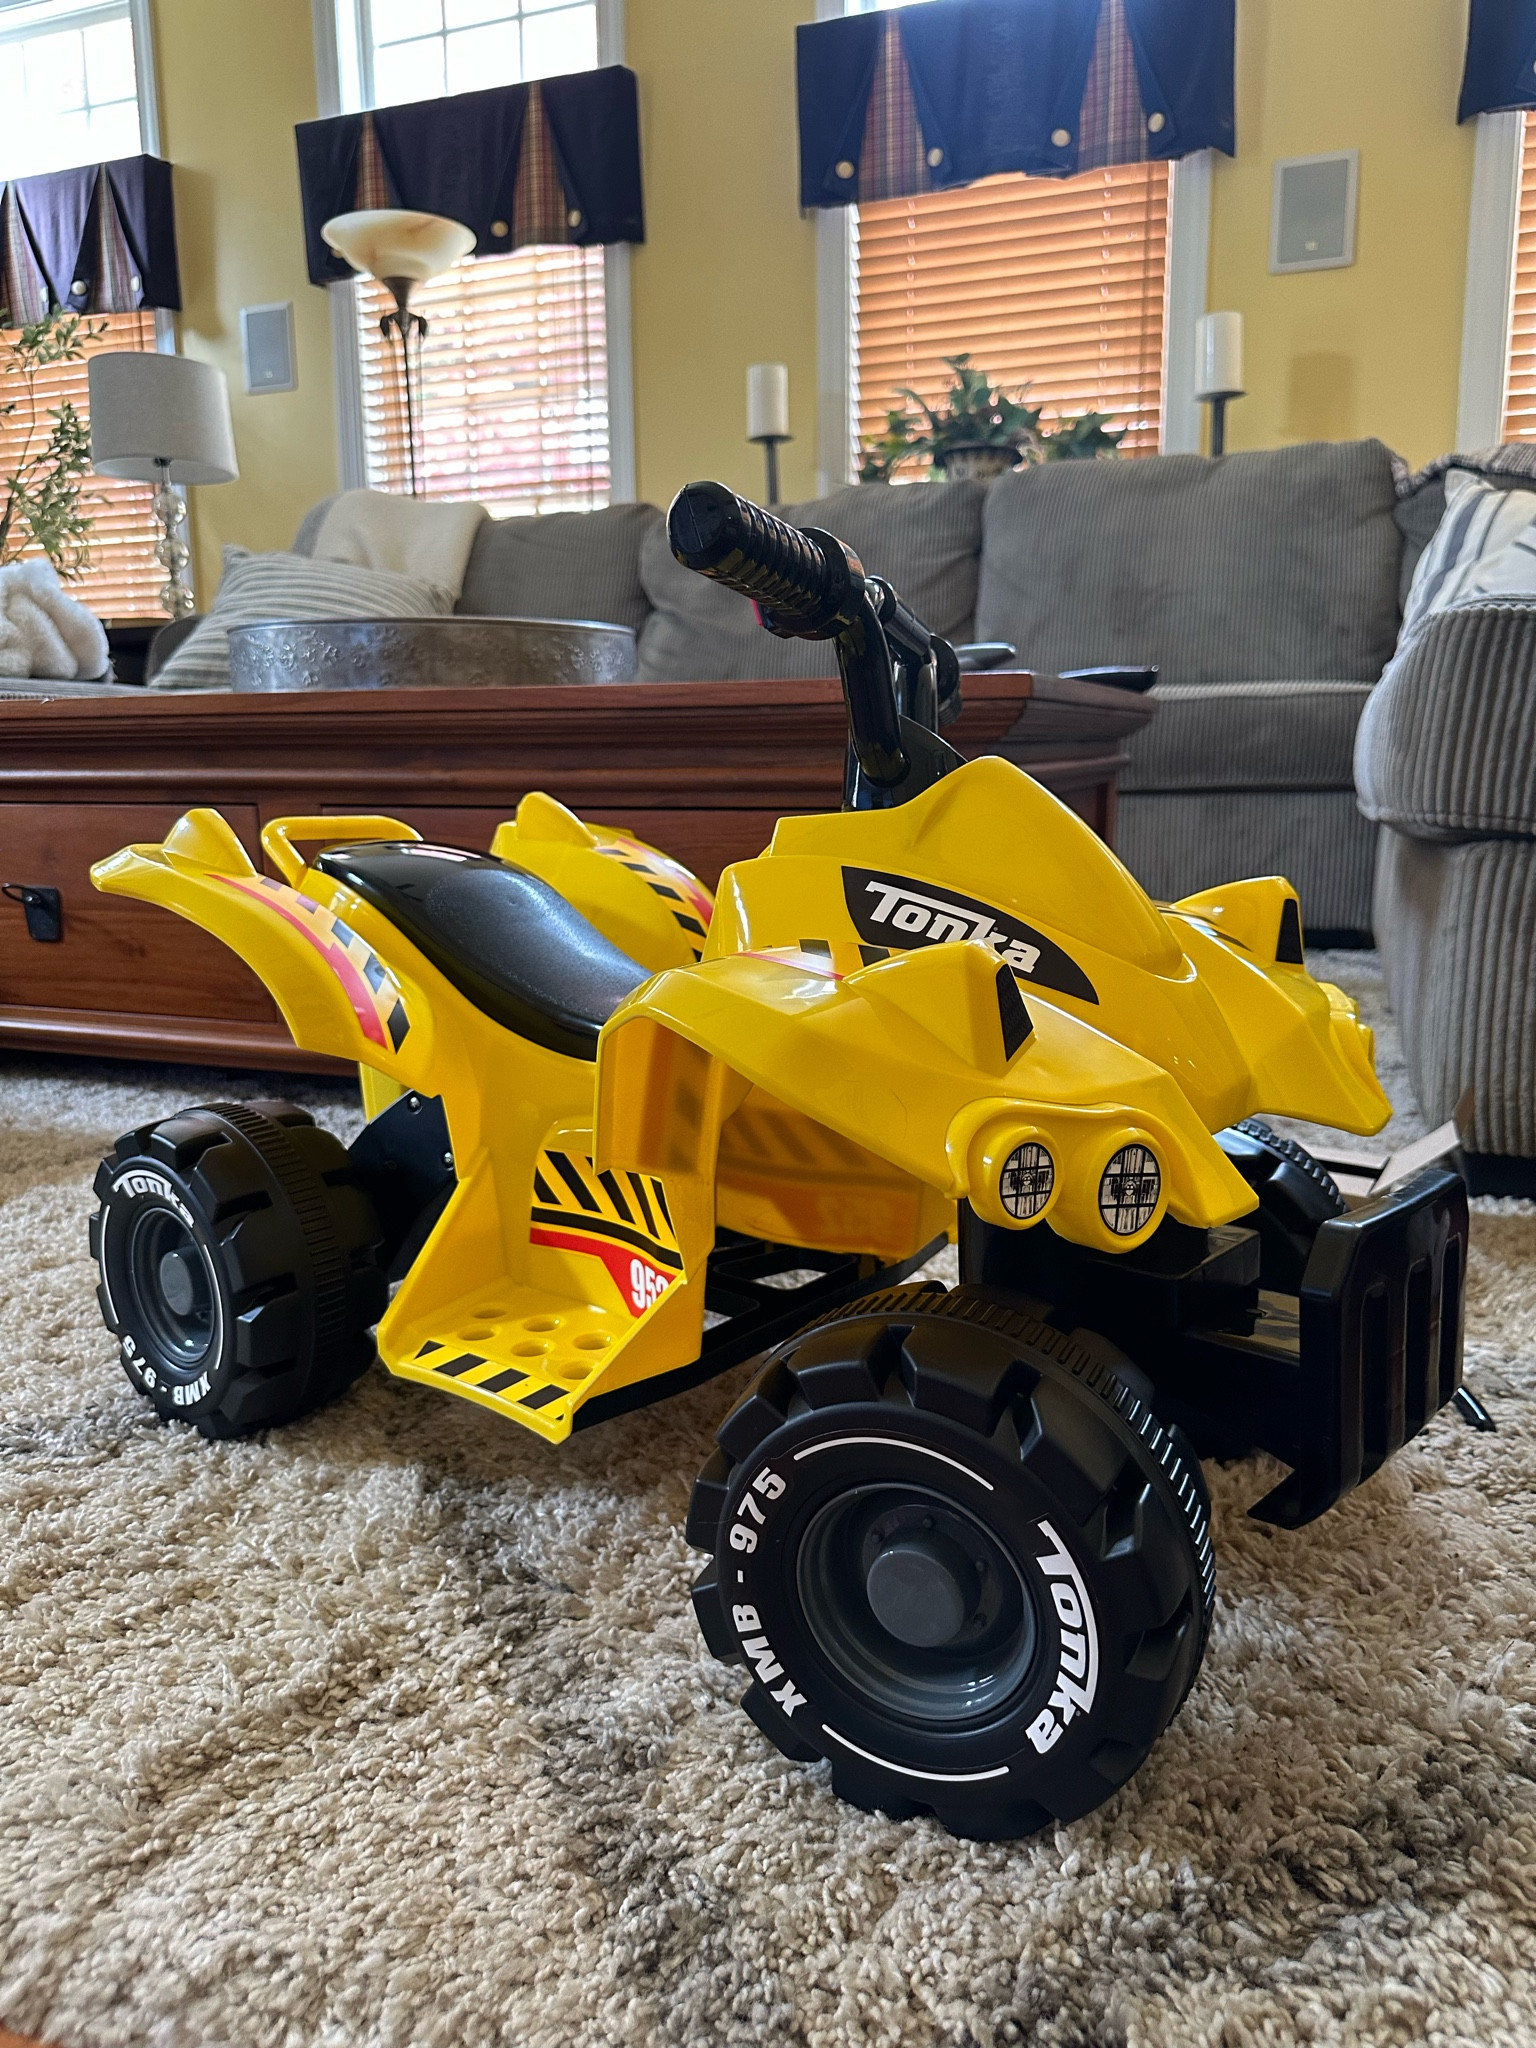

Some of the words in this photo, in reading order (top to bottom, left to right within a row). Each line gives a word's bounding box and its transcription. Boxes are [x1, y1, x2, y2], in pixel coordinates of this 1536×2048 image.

[865, 881, 1041, 973] Tonka
[113, 1169, 195, 1228] Tonka
[122, 1335, 157, 1389] 975
[172, 1372, 212, 1406] XMB
[728, 1466, 787, 1554] 975
[732, 1604, 807, 1717] XMB
[1025, 1519, 1100, 1754] Tonka
